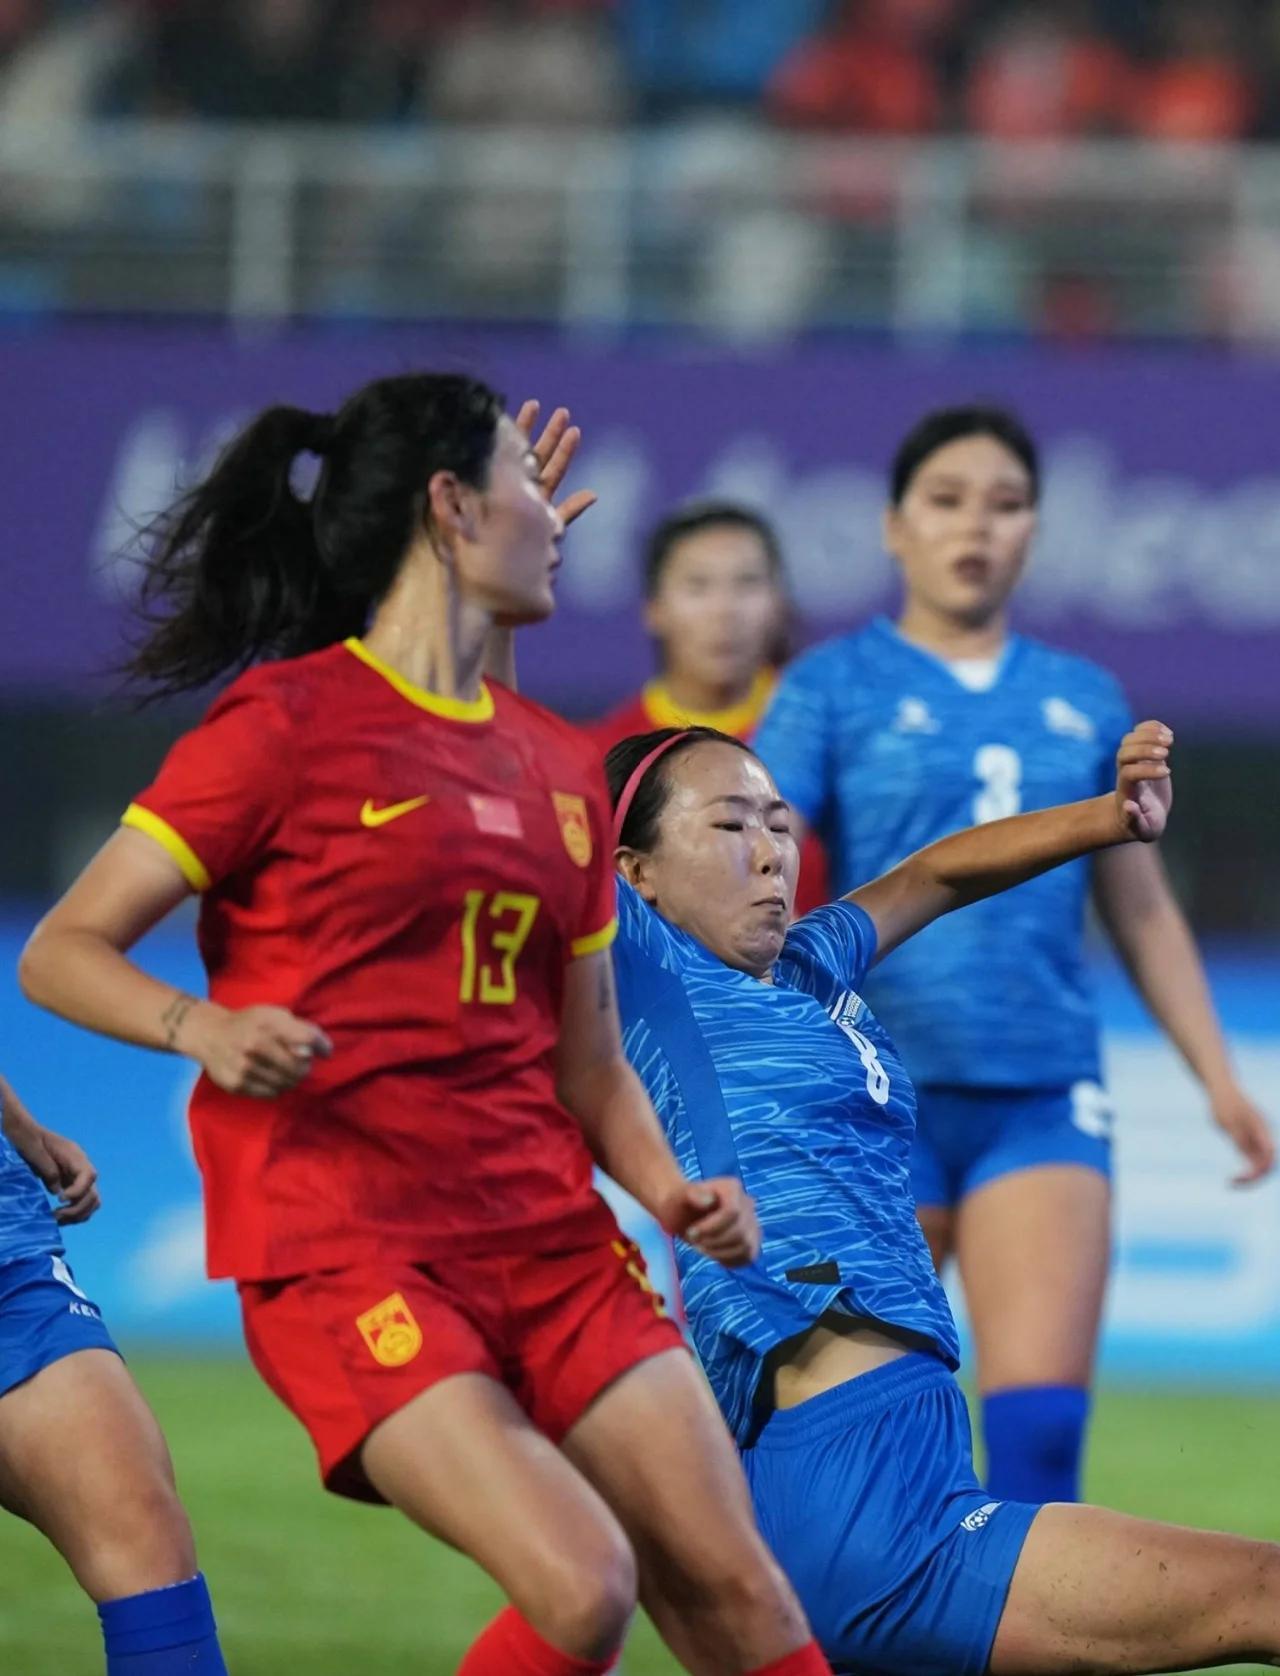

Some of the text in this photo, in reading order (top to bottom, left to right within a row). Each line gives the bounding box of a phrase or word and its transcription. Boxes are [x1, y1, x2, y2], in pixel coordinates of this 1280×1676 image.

[973, 742, 1023, 827] 3
[460, 889, 541, 1005] 13
[837, 1018, 891, 1106] 8
